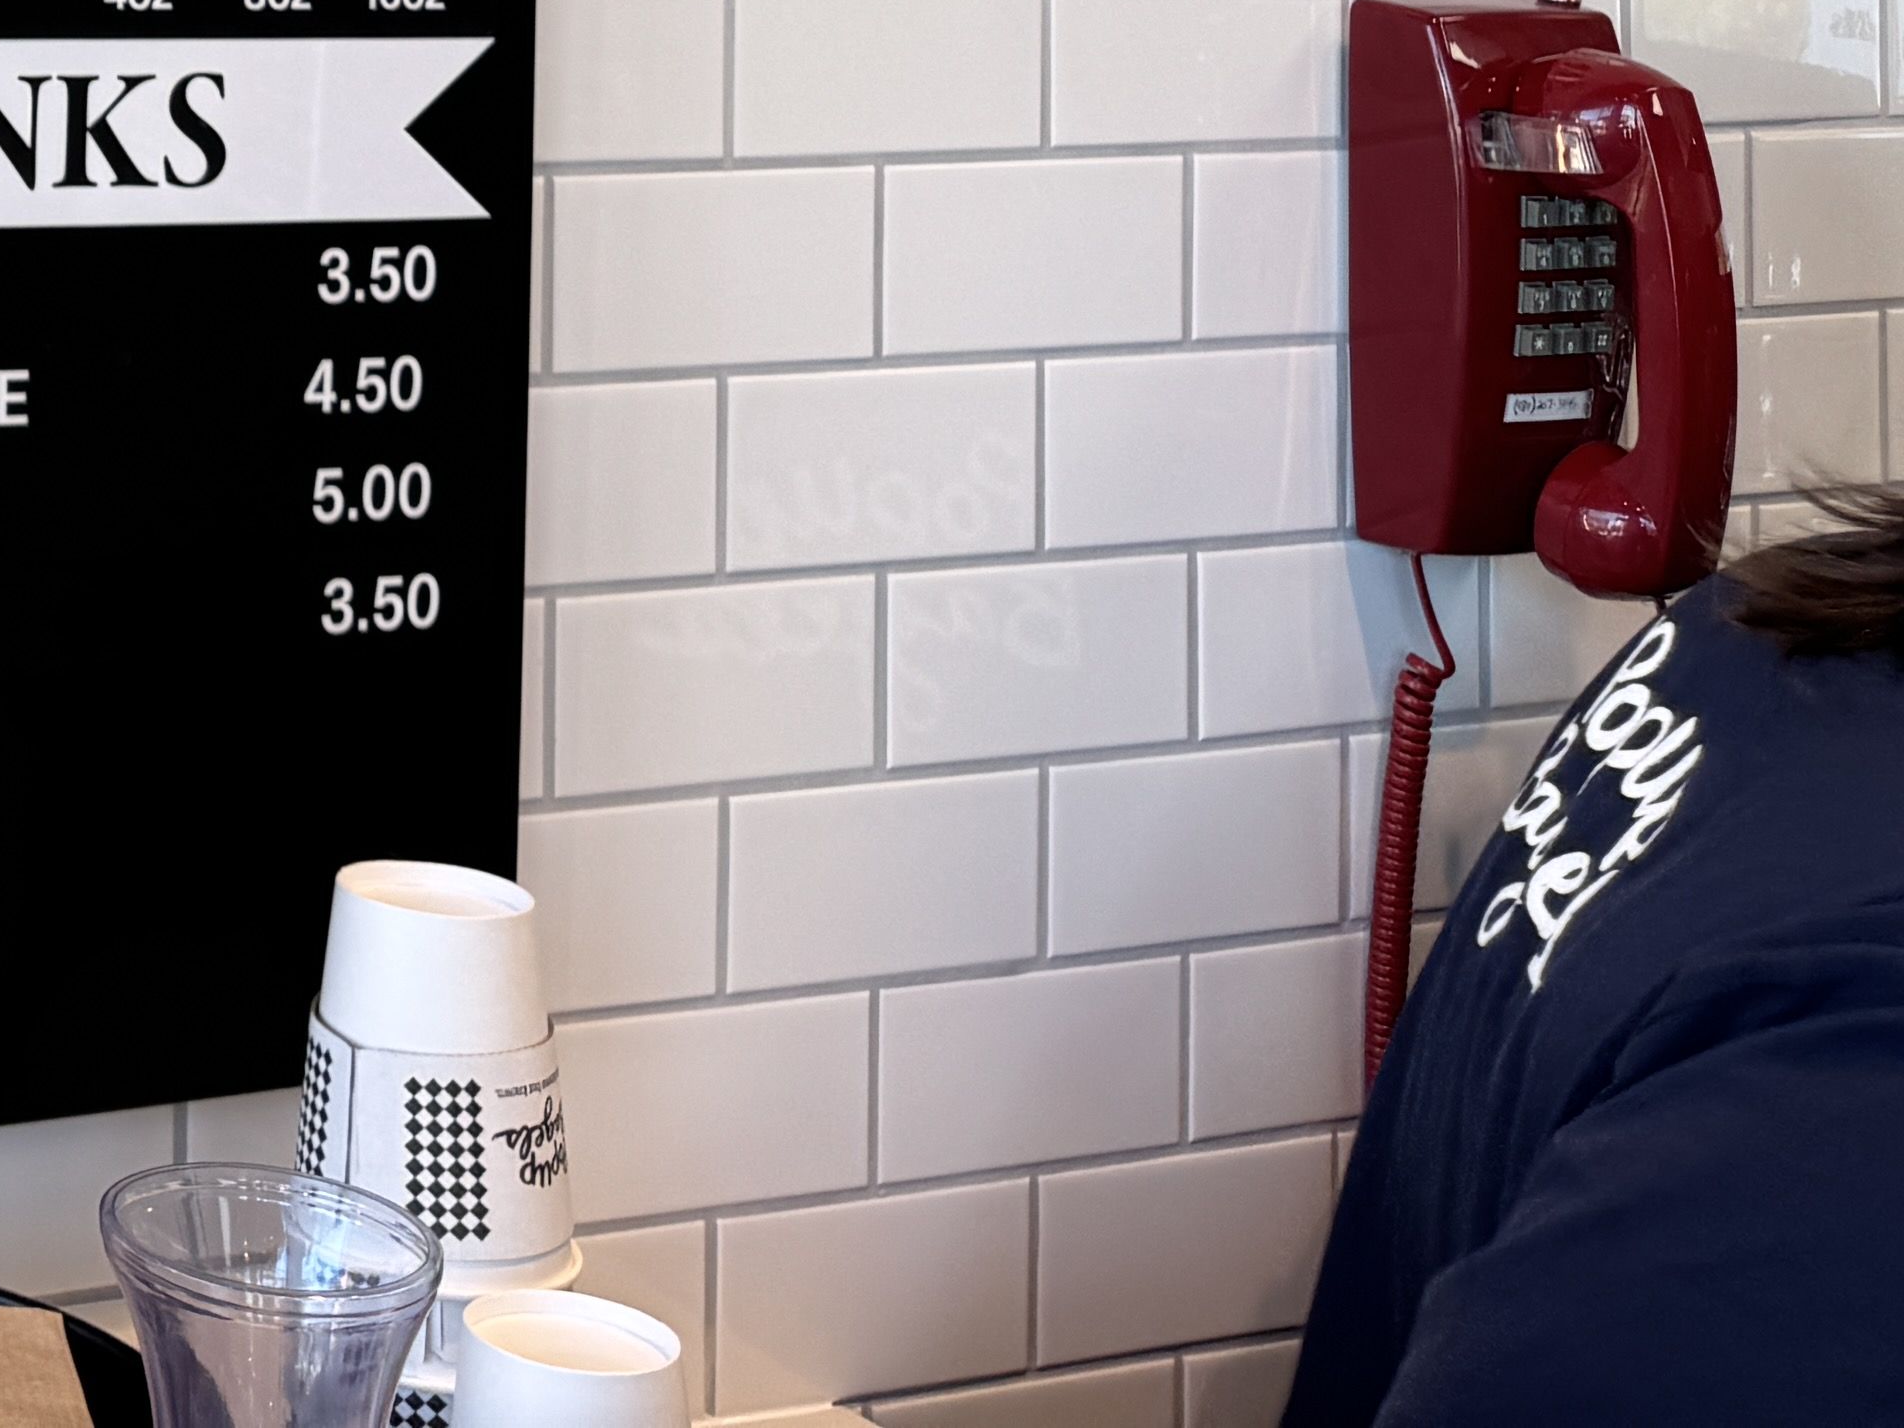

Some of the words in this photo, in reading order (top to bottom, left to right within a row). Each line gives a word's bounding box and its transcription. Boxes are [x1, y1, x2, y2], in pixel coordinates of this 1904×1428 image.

[317, 244, 437, 304] 3.50
[303, 354, 423, 414] 4.50
[312, 462, 432, 524] 5.00
[321, 572, 440, 635] 3.50
